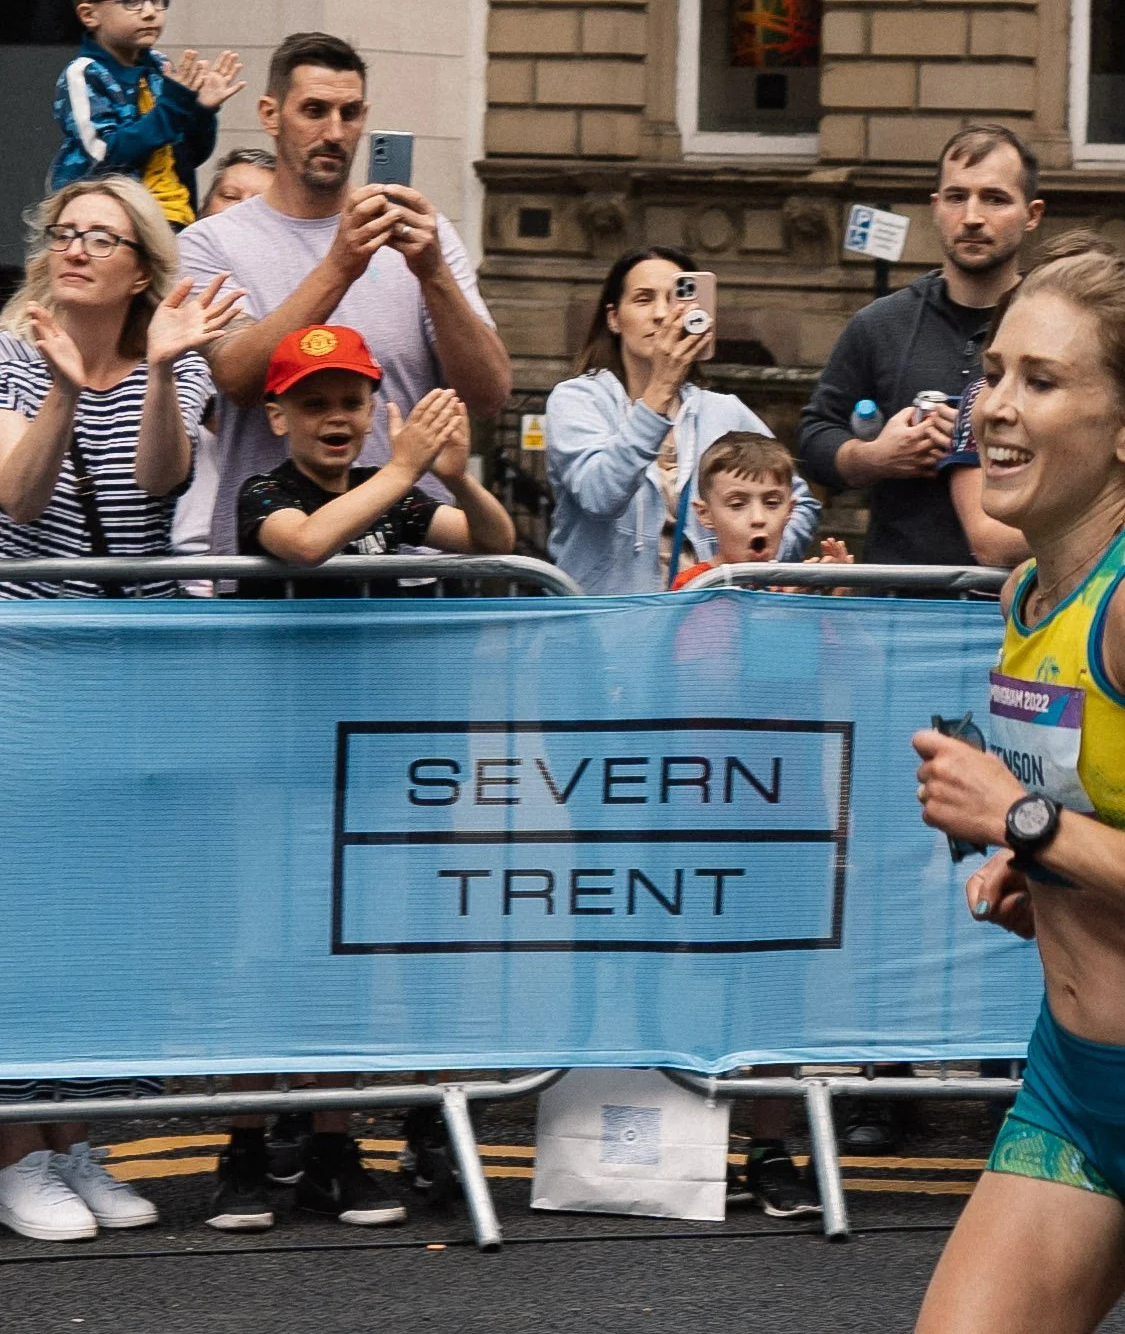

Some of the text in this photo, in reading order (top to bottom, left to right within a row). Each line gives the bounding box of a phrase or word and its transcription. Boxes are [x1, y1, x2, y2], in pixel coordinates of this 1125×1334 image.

[1024, 691, 1050, 713] 2022
[407, 756, 783, 806] SEVERN
[991, 744, 1045, 786] NSON
[437, 868, 747, 916] TRENT
